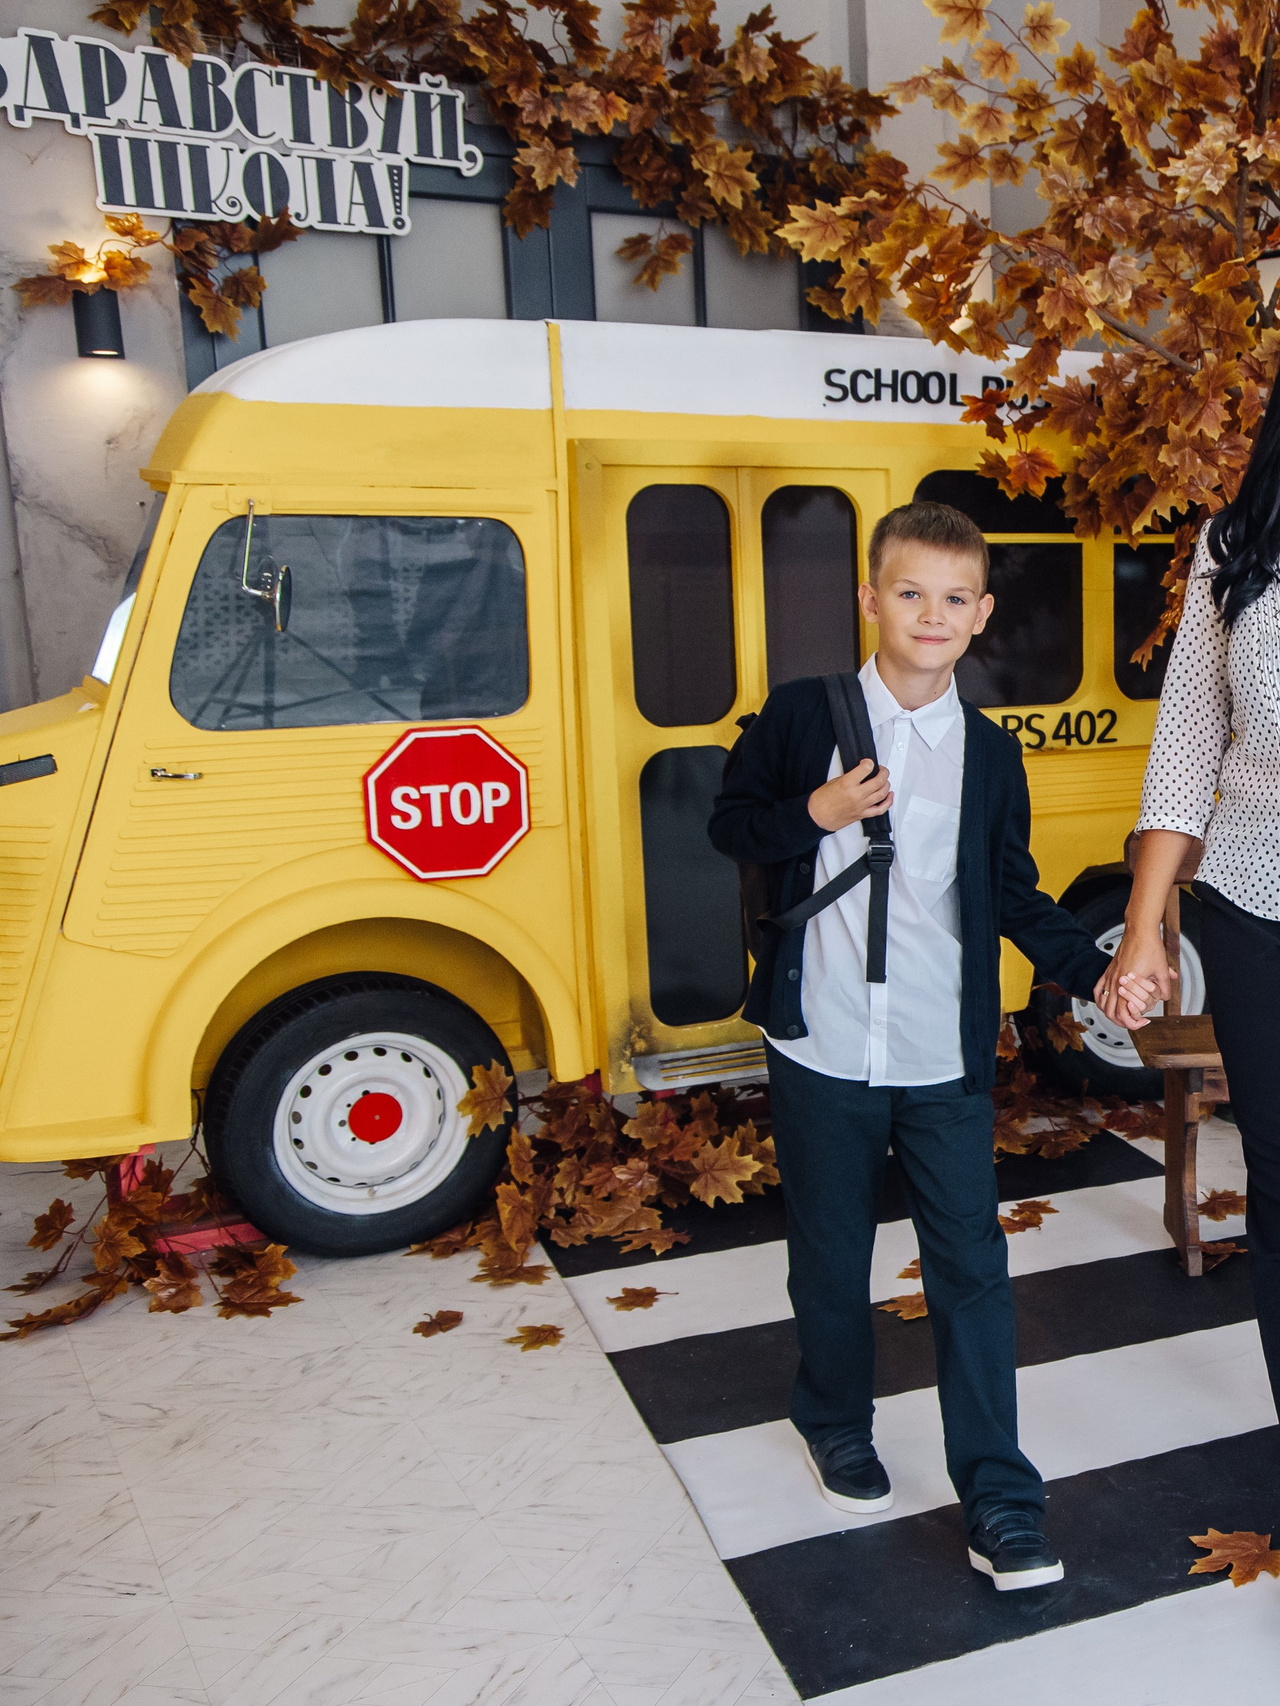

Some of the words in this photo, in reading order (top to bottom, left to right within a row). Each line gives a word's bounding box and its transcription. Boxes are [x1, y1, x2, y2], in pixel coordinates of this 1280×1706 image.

[0, 33, 477, 171] ДРАВСТВУЙ,
[98, 133, 407, 231] ШКОЛА!
[824, 367, 968, 406] SCHOOL
[1001, 713, 1046, 749] RS
[1052, 709, 1118, 746] 402
[390, 781, 510, 830] STOP
